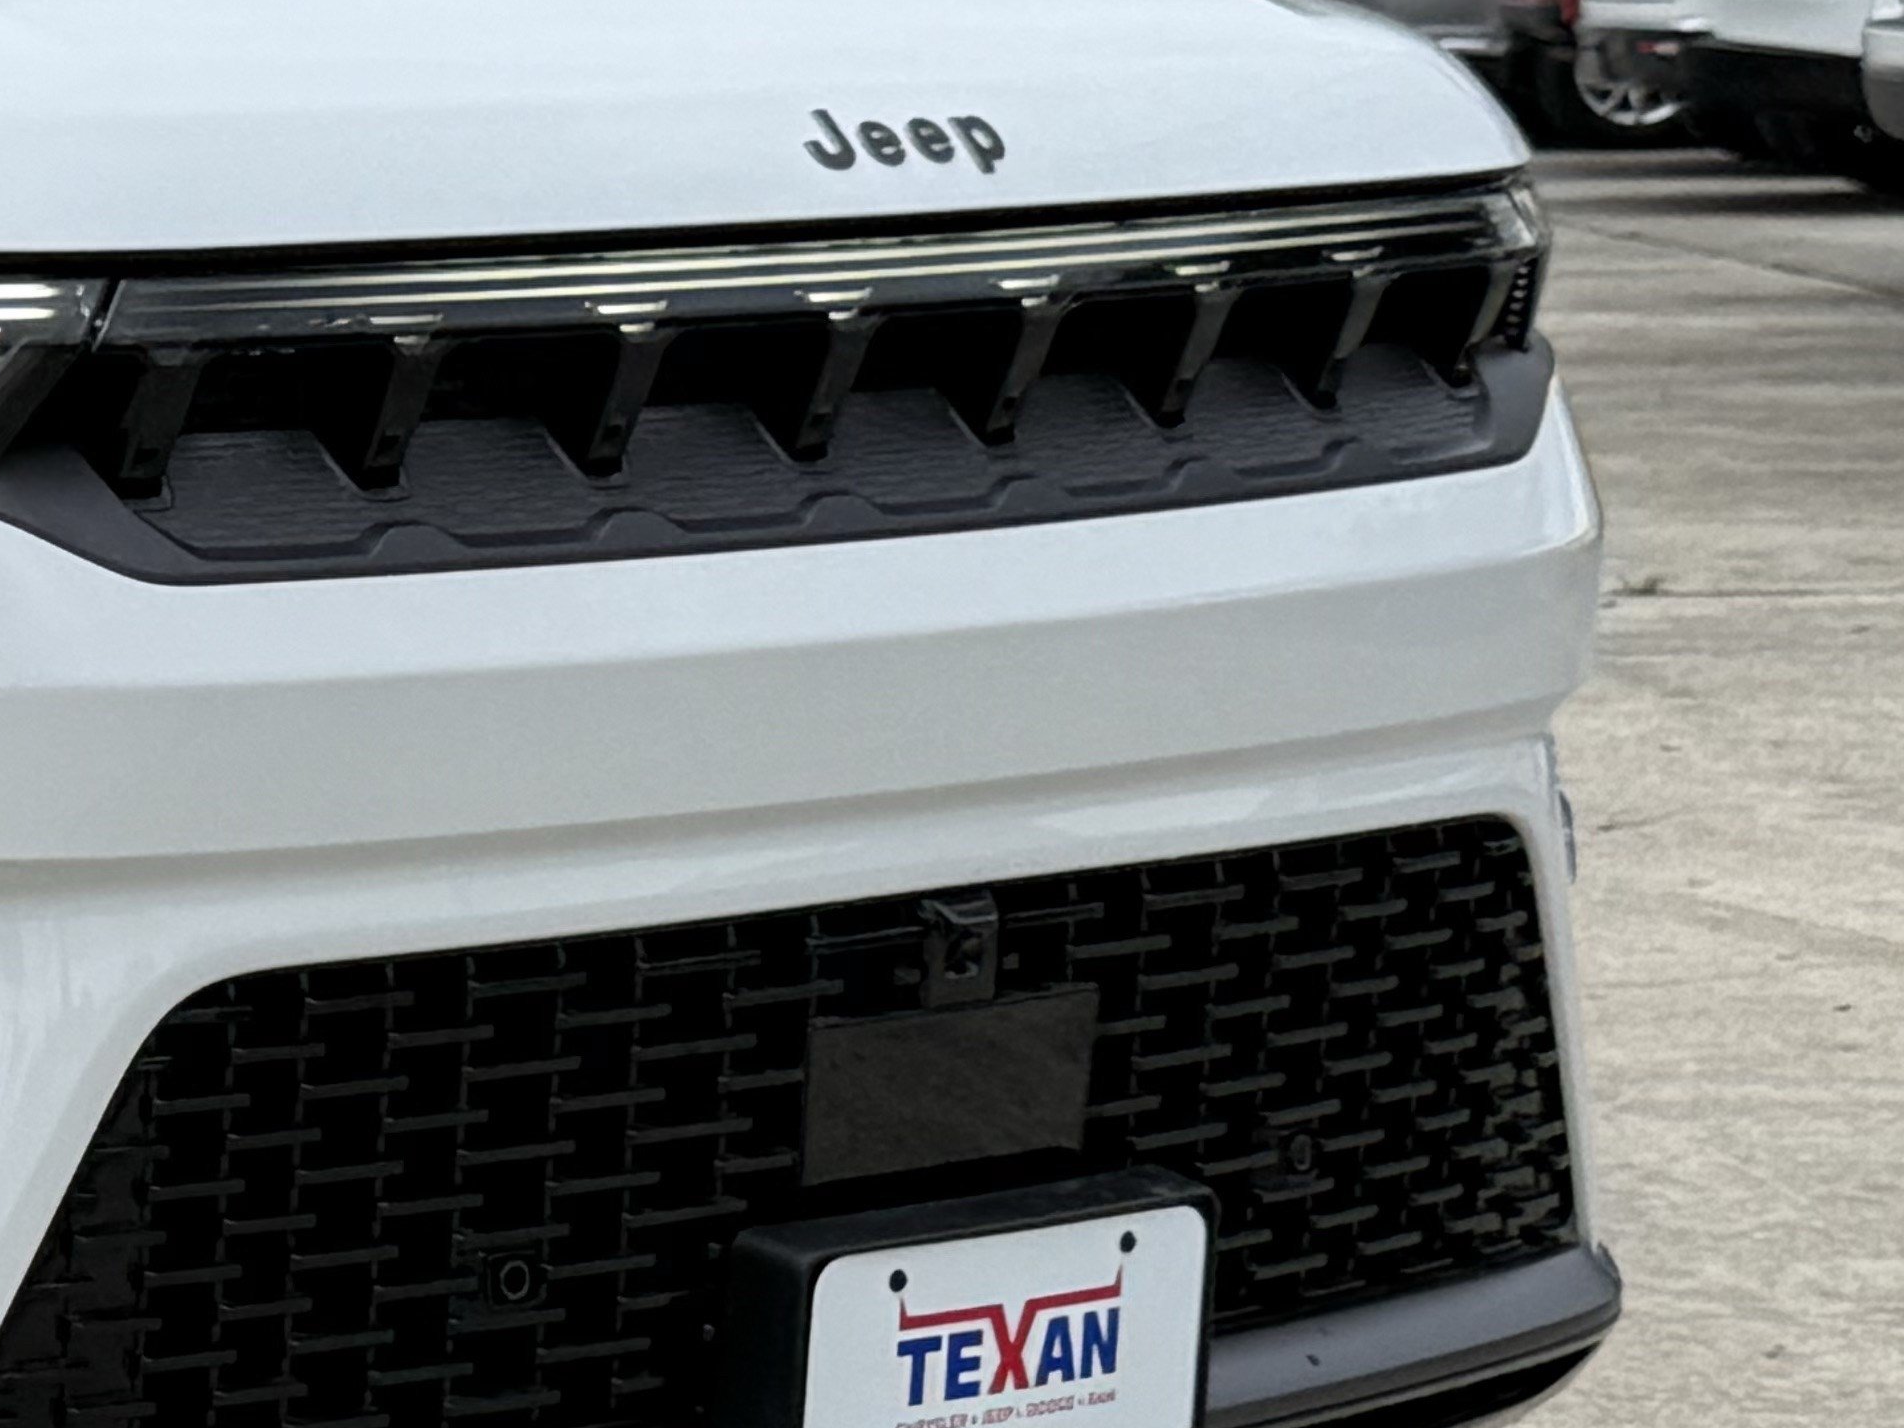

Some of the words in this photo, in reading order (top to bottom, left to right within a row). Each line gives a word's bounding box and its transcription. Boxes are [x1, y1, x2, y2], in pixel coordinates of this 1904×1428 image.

[803, 108, 1006, 175] Jeep
[896, 1302, 1122, 1407] TEXAN
[1025, 1395, 1075, 1418] DODGE
